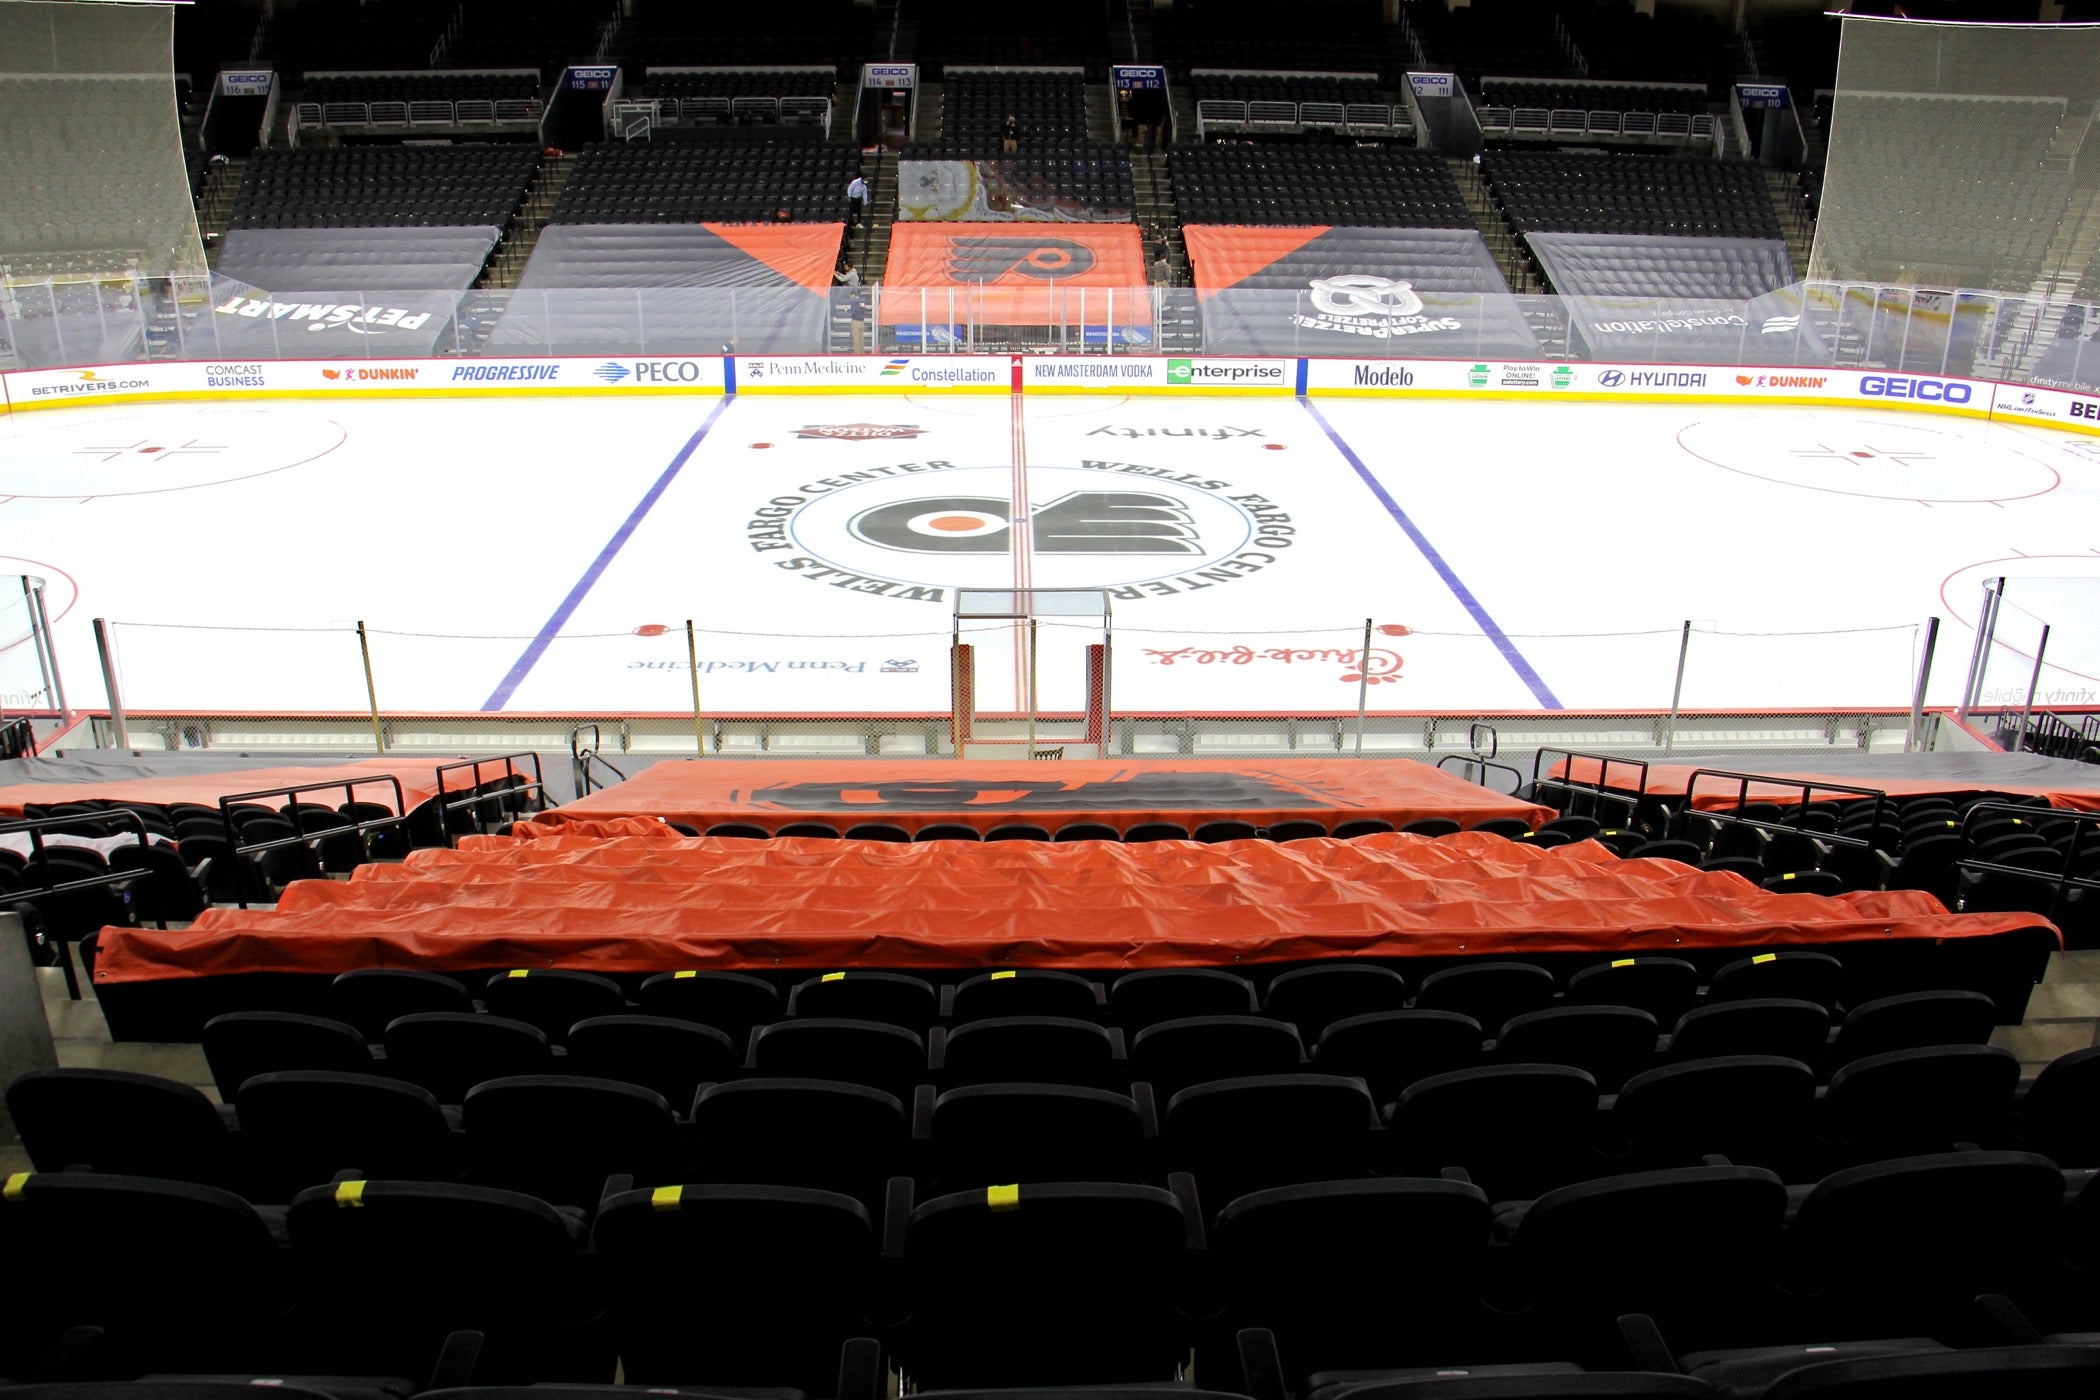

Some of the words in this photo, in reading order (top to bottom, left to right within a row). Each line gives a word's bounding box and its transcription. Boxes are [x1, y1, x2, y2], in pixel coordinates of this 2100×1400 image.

[574, 70, 611, 79] GEICO
[872, 68, 908, 76] GEICO
[1120, 69, 1157, 78] GEICO
[228, 75, 267, 83] GEICO
[571, 80, 586, 89] 115
[898, 78, 912, 86] 113
[1117, 79, 1130, 88] 113
[1146, 79, 1160, 88] 112
[1412, 76, 1448, 84] GEICO
[1742, 88, 1779, 97] GEICO
[215, 297, 432, 330] PETSMART
[1318, 314, 1388, 327] PRETZELS
[1389, 315, 1428, 326] SOFT
[1594, 314, 1748, 334] Constellation
[206, 365, 262, 375] COMCAST
[452, 365, 560, 381] PROGRESSIVE
[635, 361, 699, 382] PECO
[769, 362, 801, 374] Penn
[804, 360, 866, 374] Medicine
[1035, 365, 1056, 378] NEW
[1058, 365, 1118, 378] AMSTERDAM
[1120, 365, 1153, 378] VODKA
[1169, 364, 1282, 380] enterprise
[1503, 364, 1518, 372] Play
[359, 368, 419, 380] DUNKIN'
[912, 367, 995, 382] Constellation
[1354, 365, 1414, 386] Modelo
[1630, 372, 1706, 387] HYUNDAI
[31, 380, 150, 396] BETRIVERS.COM
[207, 376, 265, 387] BUSINESS
[1769, 375, 1827, 388] DUNKIN'
[1859, 376, 1972, 404] GEICO
[1086, 425, 1266, 440] xfinity
[798, 460, 956, 493] CENTER
[1080, 460, 1233, 490] WELLS
[747, 496, 806, 552] FARGO
[1227, 493, 1296, 549] FARGO
[774, 557, 944, 602] WELLS
[1108, 552, 1276, 600] CENTER
[627, 661, 780, 673] Medicine
[788, 661, 866, 673] Penn
